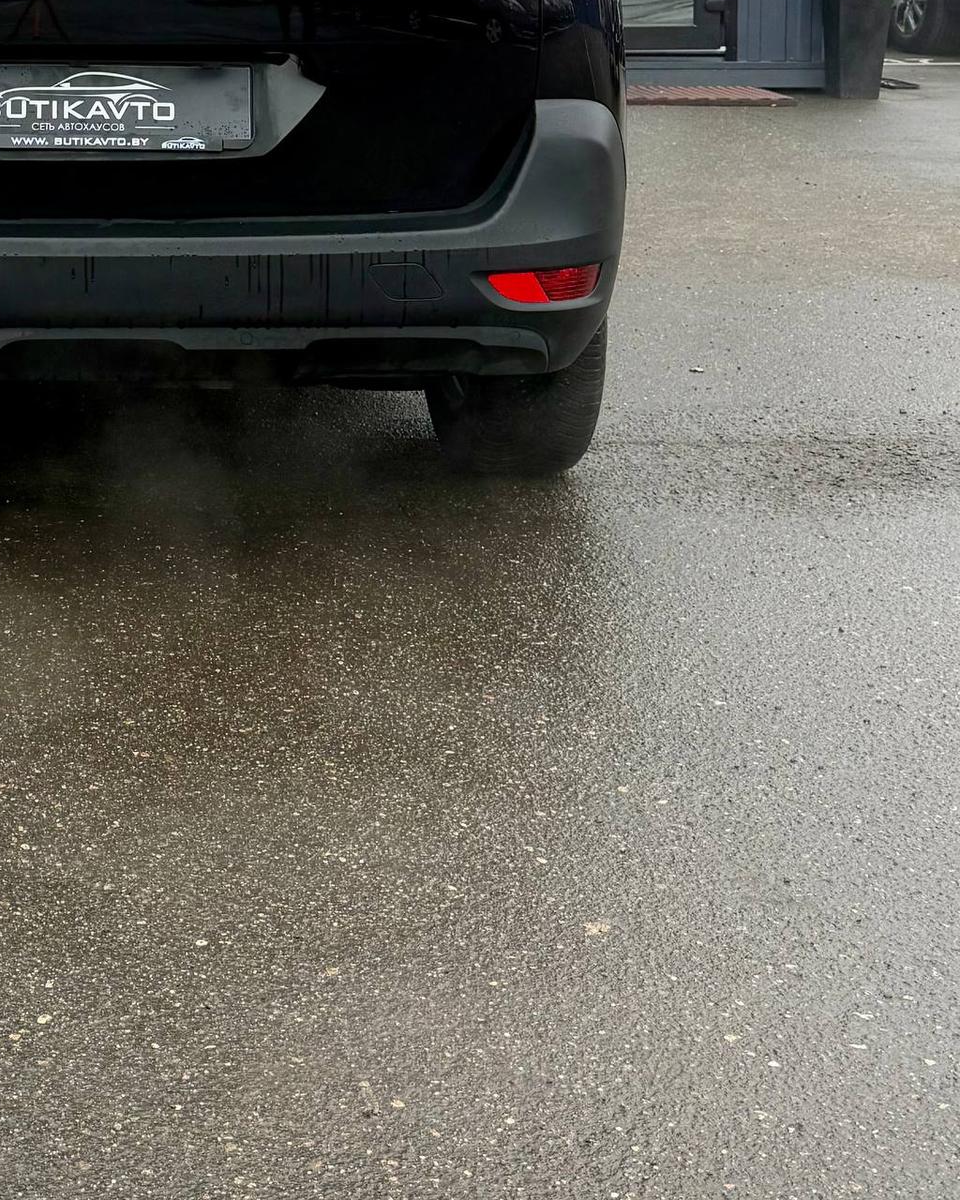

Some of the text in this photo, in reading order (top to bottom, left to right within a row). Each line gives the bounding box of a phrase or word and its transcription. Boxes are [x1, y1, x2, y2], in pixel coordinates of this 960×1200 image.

[31, 122, 125, 132] СЕТЬ АВТОХАУСОВ
[11, 136, 150, 147] WWW. BUTIKAVTO.BY
